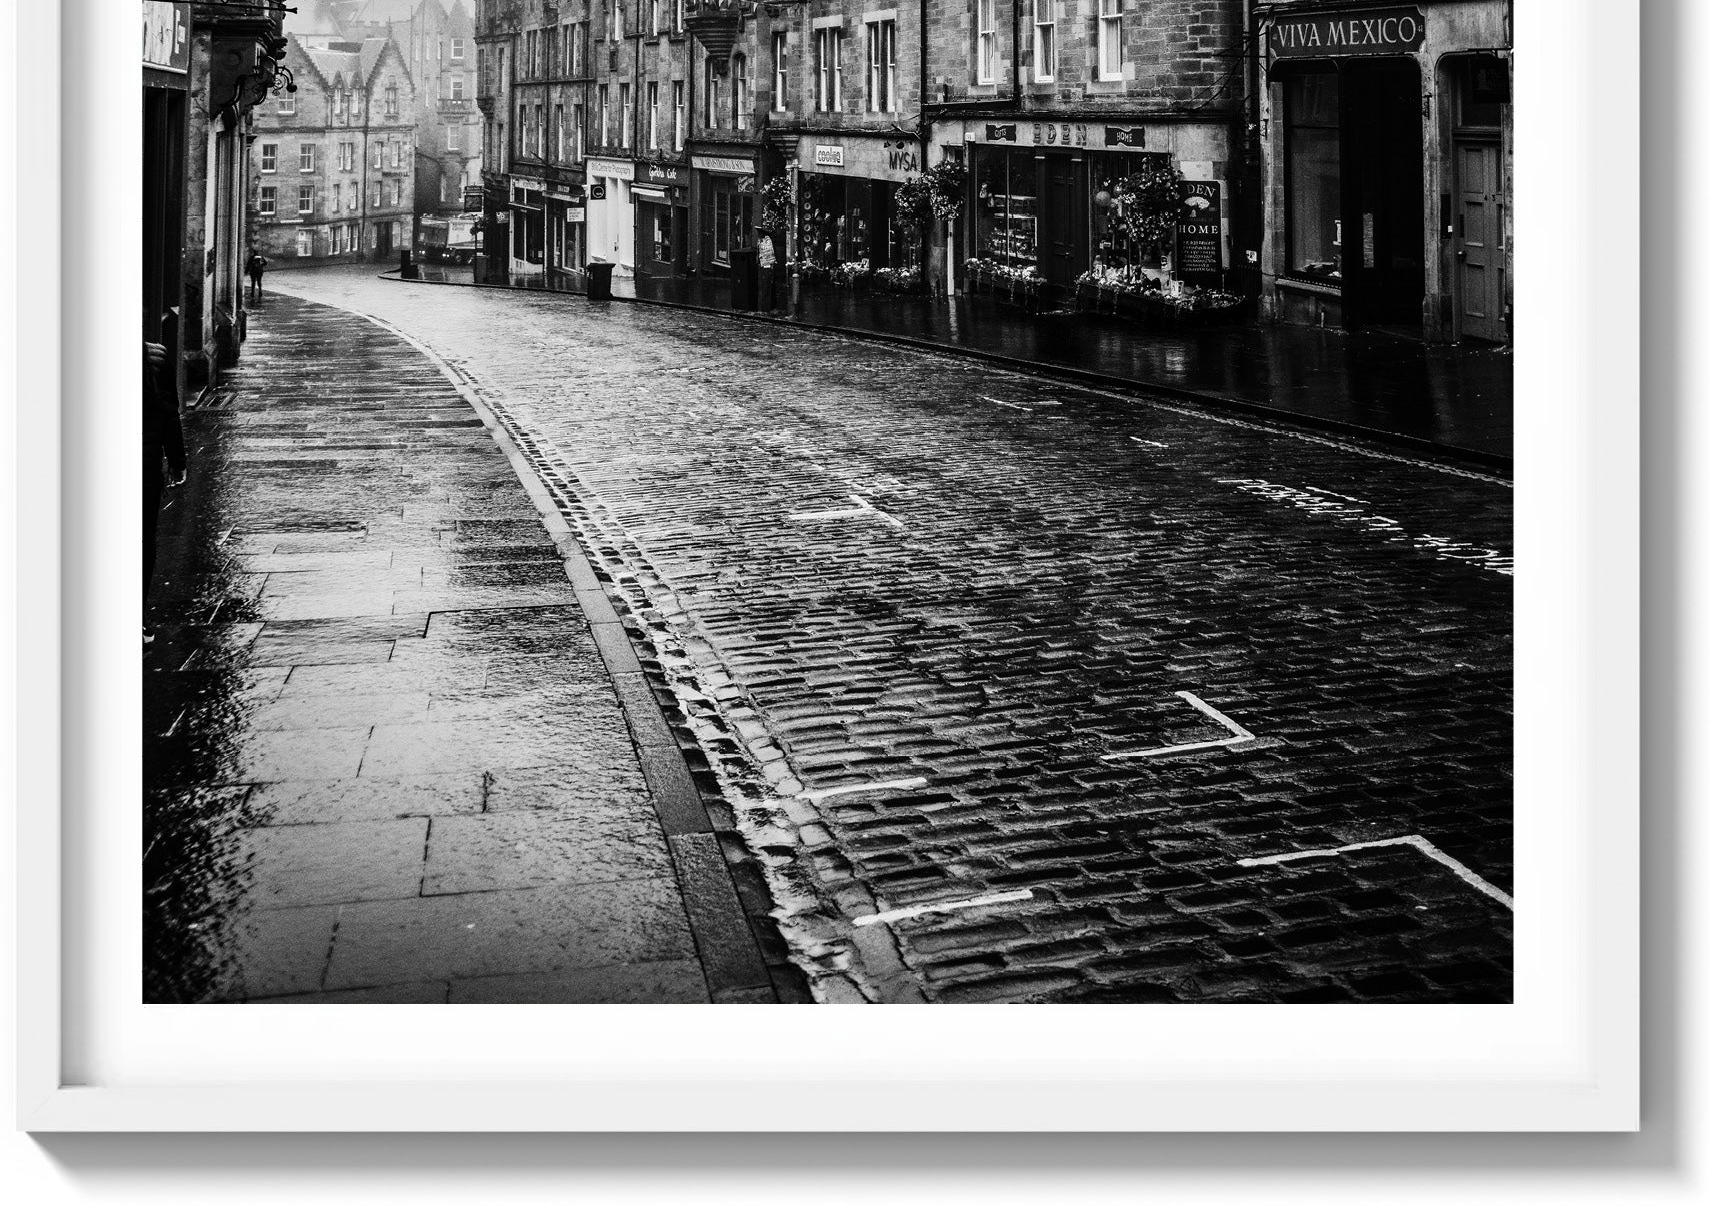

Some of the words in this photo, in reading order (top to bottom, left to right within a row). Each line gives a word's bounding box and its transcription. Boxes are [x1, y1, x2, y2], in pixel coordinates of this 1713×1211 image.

[1277, 23, 1321, 47] VIVA
[1326, 16, 1417, 47] MEXICO
[1033, 123, 1088, 146] EDEN
[1116, 132, 1133, 143] HOME
[889, 151, 917, 171] MYSA
[1187, 184, 1216, 197] DEN
[1179, 224, 1218, 234] HOME
